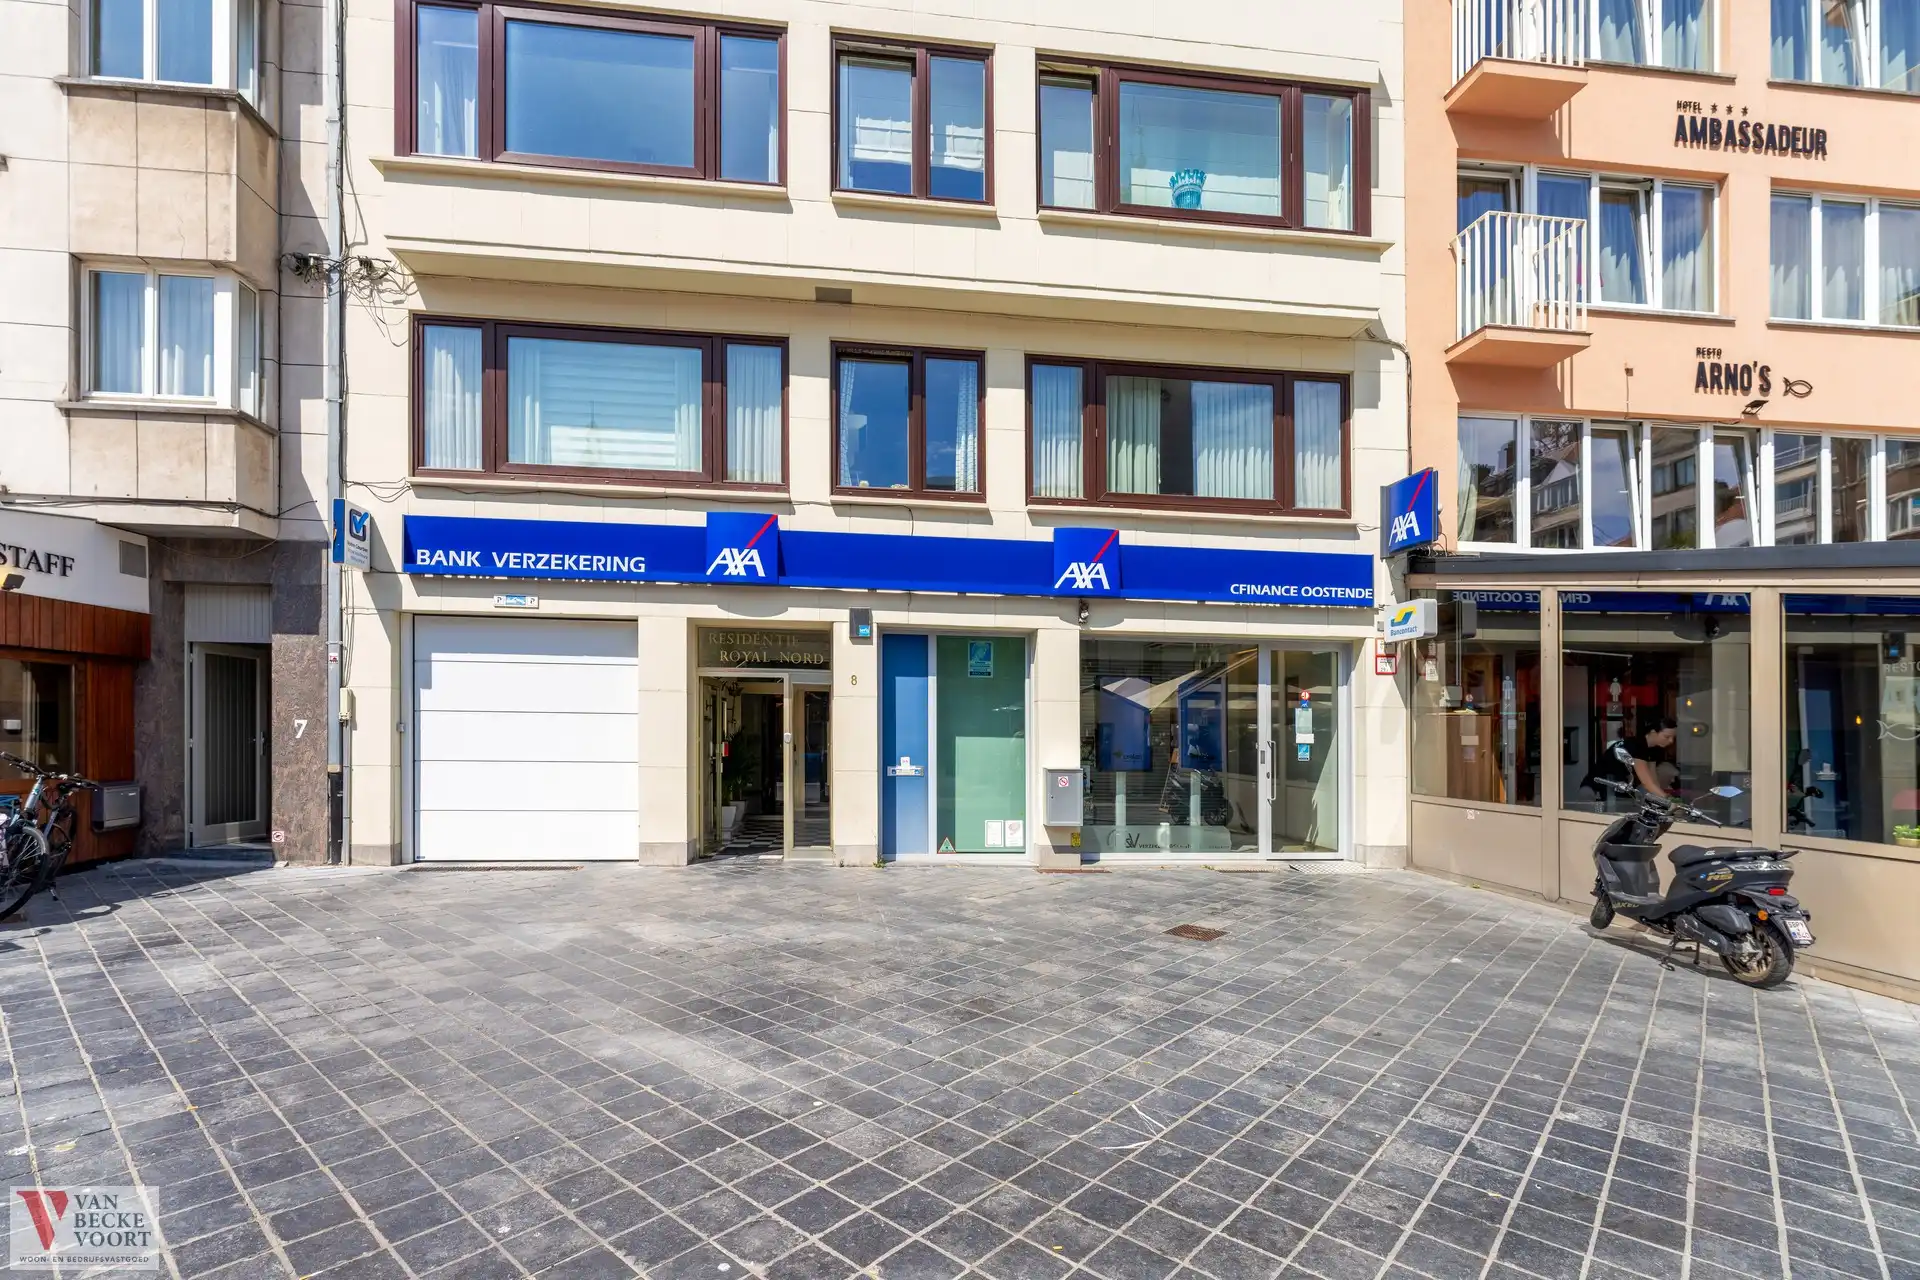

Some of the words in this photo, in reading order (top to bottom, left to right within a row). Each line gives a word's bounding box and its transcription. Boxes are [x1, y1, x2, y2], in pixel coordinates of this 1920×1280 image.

[1676, 100, 1703, 112] HOTEL
[1675, 115, 1828, 157] AMBASSADEUR
[1696, 347, 1722, 358] RESTO
[1695, 361, 1771, 393] ARNO'S
[1389, 510, 1420, 546] AXA
[416, 549, 481, 568] BANK
[492, 551, 646, 573] VERZEKERING
[706, 547, 766, 577] AXA
[1054, 562, 1110, 590] AXA
[1230, 584, 1298, 596] CFINANCE
[1301, 586, 1373, 599] OOSTENDE
[1390, 626, 1418, 637] Bancontact
[720, 651, 771, 663] ROYAL
[780, 651, 824, 665] NORD
[850, 675, 858, 685] 8
[294, 719, 308, 738] 7
